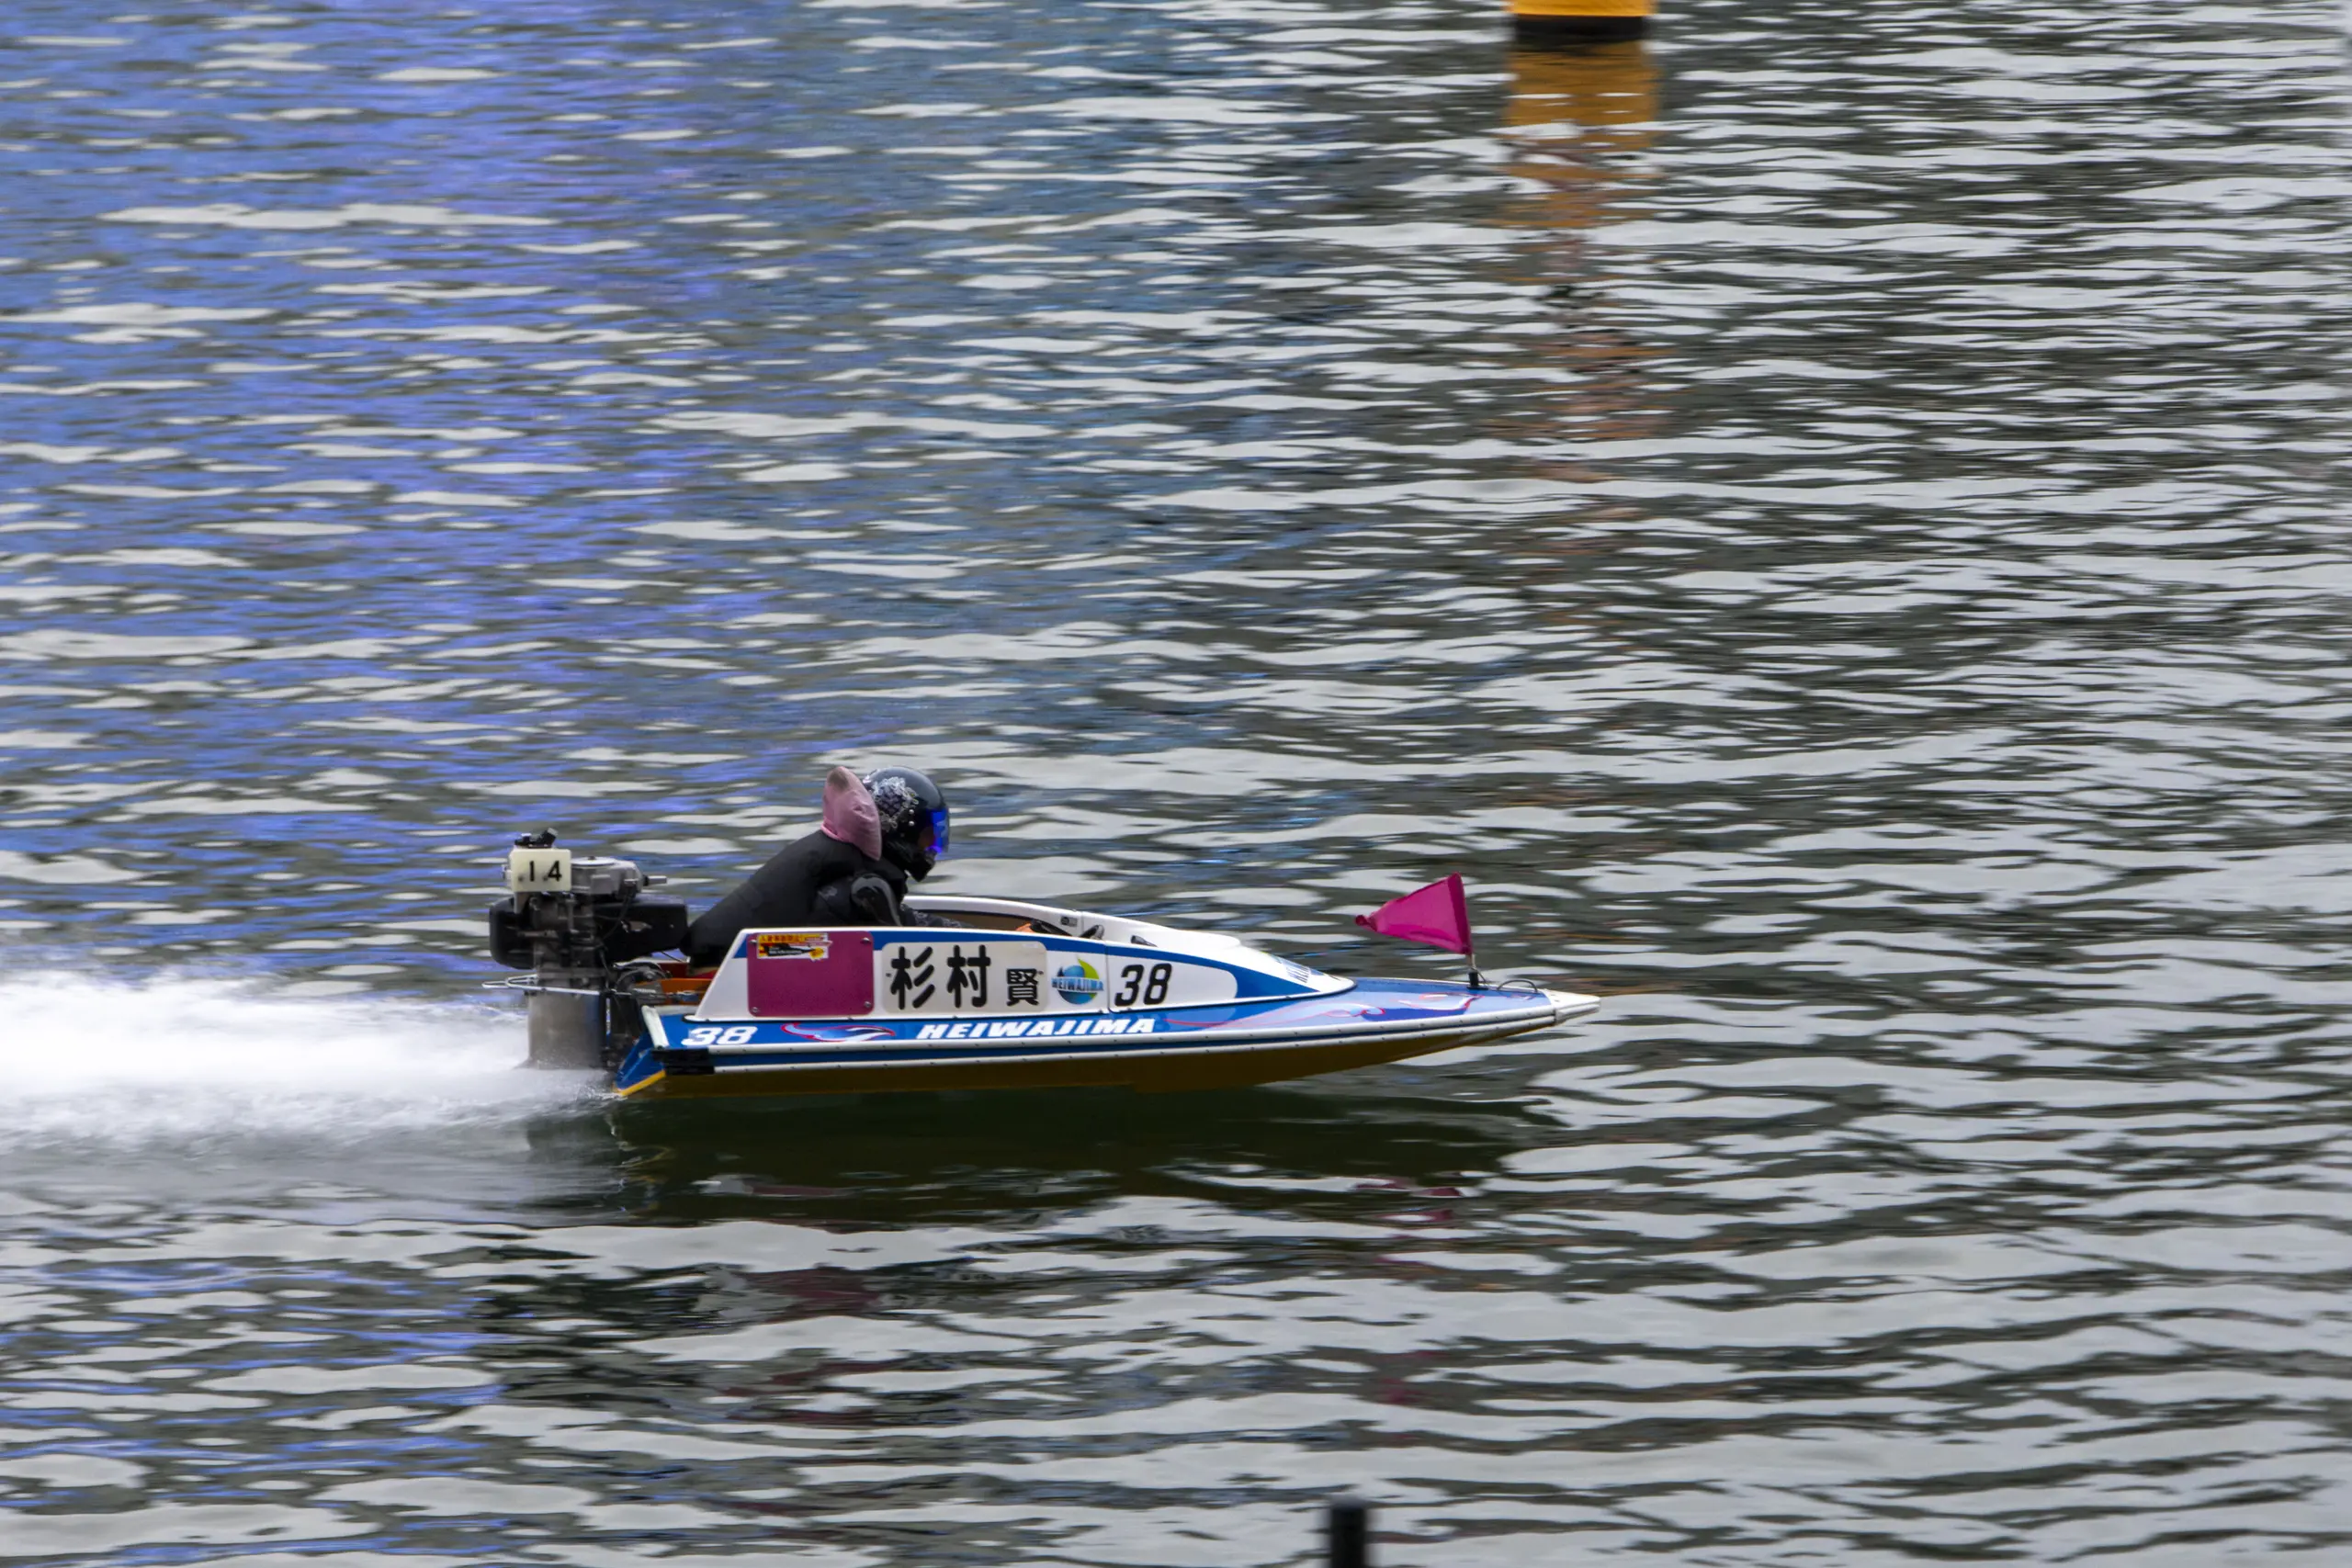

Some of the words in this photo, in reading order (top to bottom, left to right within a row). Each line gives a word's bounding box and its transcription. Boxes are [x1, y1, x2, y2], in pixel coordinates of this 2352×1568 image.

[528, 860, 562, 883] 14
[1051, 976, 1104, 992] HEIWAJIMA
[1114, 963, 1173, 1007] 38
[681, 1026, 758, 1045] 38
[915, 1018, 1156, 1040] HEIWAJIMA
